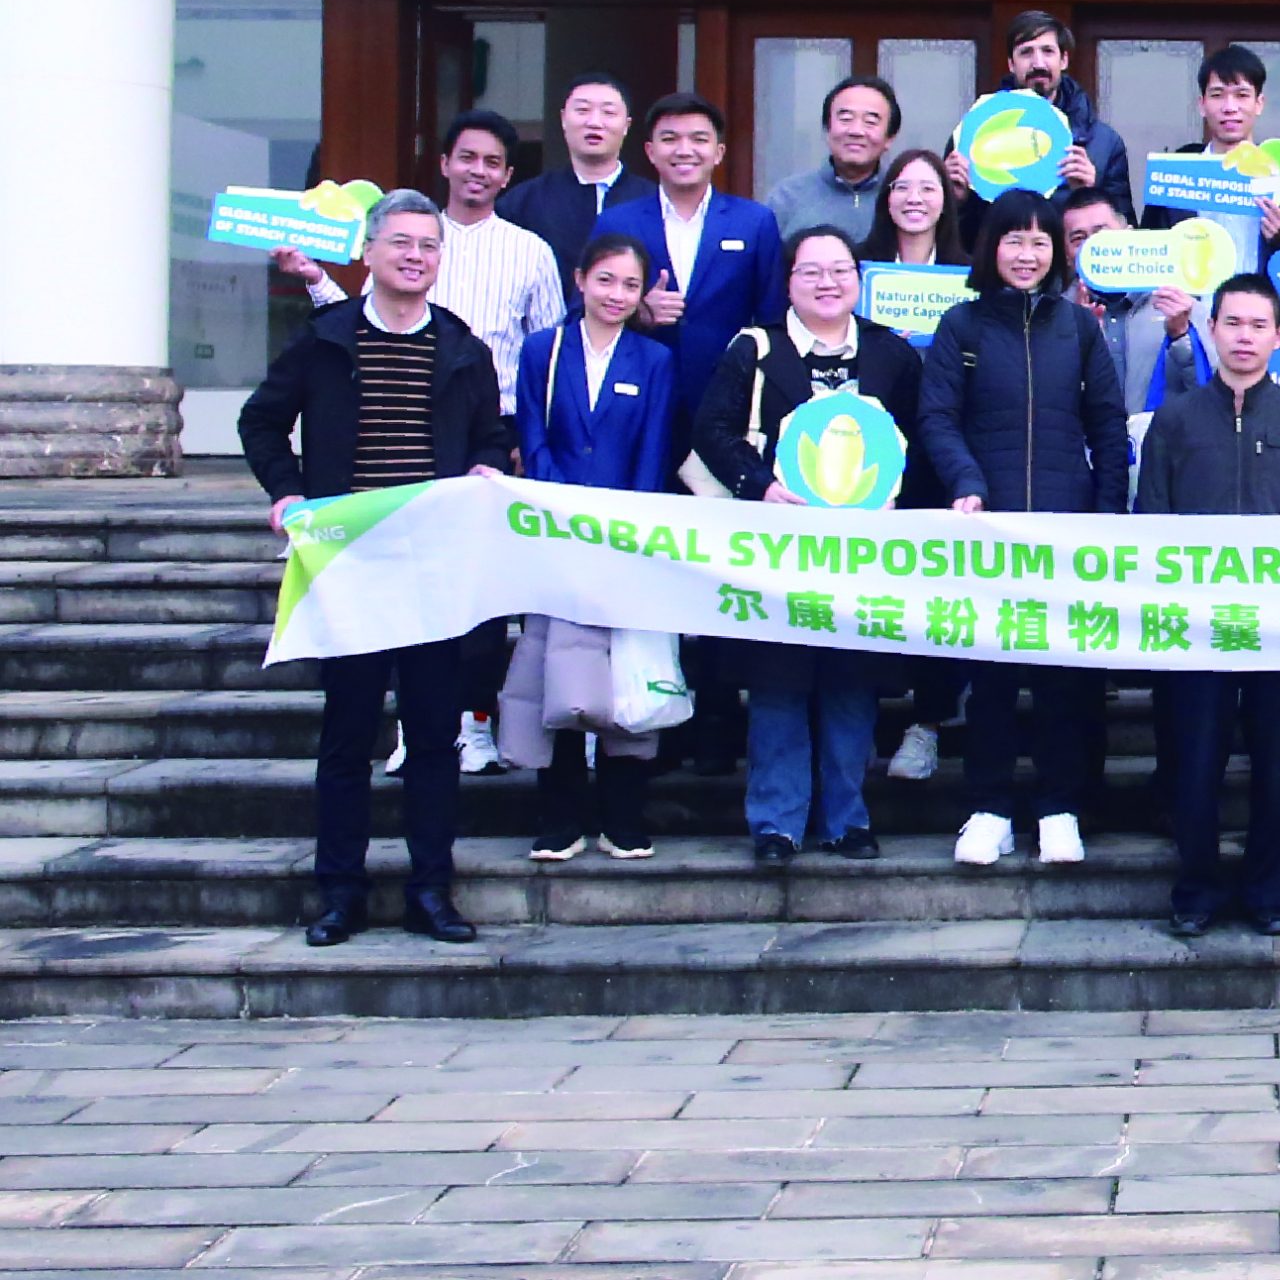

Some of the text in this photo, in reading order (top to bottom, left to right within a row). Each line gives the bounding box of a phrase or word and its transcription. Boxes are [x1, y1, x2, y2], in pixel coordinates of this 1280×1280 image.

[1150, 171, 1195, 187] GLOBAL
[1149, 185, 1165, 196] OF
[1167, 187, 1211, 201] STARCH
[218, 206, 350, 239] GLOBAL SYMPOSIUM
[215, 221, 347, 254] OF STARCH CAPSULE
[1090, 244, 1168, 258] New Trend
[1090, 261, 1175, 275] New Choice
[875, 291, 924, 303] Natural
[876, 305, 909, 318] Vege
[508, 500, 710, 564] GLOBAL
[728, 530, 1054, 581] SYMPOSIUM
[1073, 545, 1140, 583] OF
